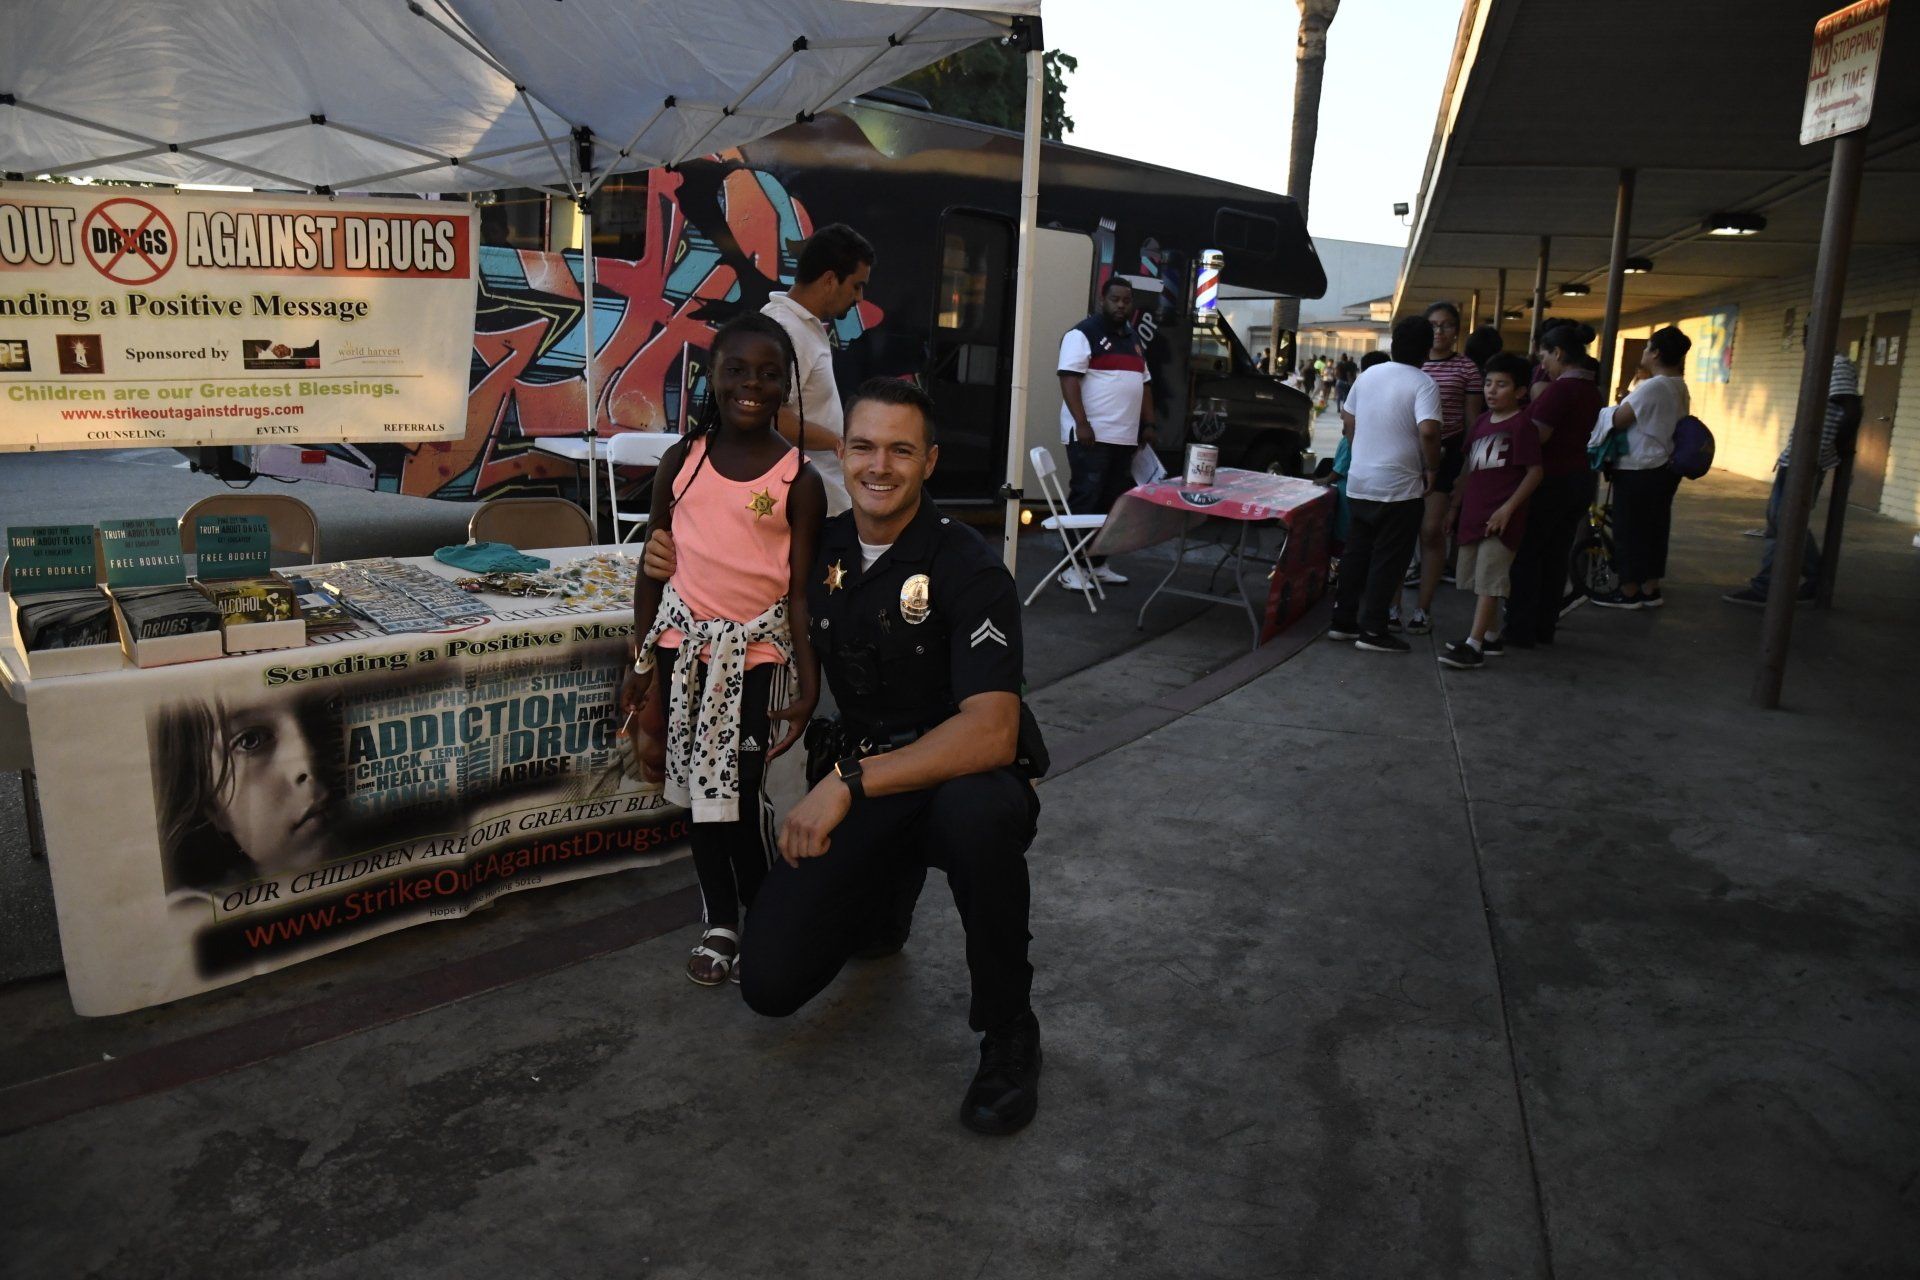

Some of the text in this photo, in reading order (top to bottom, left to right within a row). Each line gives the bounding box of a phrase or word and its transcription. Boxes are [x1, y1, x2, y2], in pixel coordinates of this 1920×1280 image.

[1811, 26, 1880, 78] NO STOPPING
[1815, 66, 1867, 99] ANY TIME
[0, 204, 76, 265] OUT
[187, 212, 338, 269] AGAINST
[344, 217, 456, 271] DRUGS
[100, 302, 117, 315] a
[128, 294, 243, 316] Positive
[253, 295, 369, 322] Message
[125, 347, 229, 363] Sponsored by
[339, 347, 401, 356] world harvest
[8, 381, 400, 402] Children are our Greatest Blessings.
[61, 404, 304, 421] www.strikeoutagainstdrugs.com
[87, 423, 445, 440] COUNSELING EVENTS REFERRALS
[104, 530, 126, 540] TRUTH
[200, 526, 220, 535] TRUTH
[12, 537, 35, 547] TRUTH
[110, 555, 180, 569] FREE BOOKLET
[200, 551, 267, 563] FREE BOOKLET
[15, 565, 92, 577] FREE BOOKLET
[218, 596, 263, 615] ALCOHOL
[140, 617, 189, 639] DRUGS
[266, 654, 409, 686] Sending
[418, 649, 436, 662] a
[448, 632, 563, 657] Positive
[348, 691, 577, 765] ADDICTION
[510, 718, 617, 765] DRUG
[357, 752, 421, 780] CRACK
[500, 755, 571, 787] ABUSE
[376, 763, 446, 791] HEALTH
[223, 881, 280, 912] OUR
[291, 845, 417, 894] CHILDREN
[421, 835, 468, 859] ARE
[471, 819, 511, 847] OUR
[519, 800, 622, 830] GREATEST
[429, 907, 456, 917] Hope
